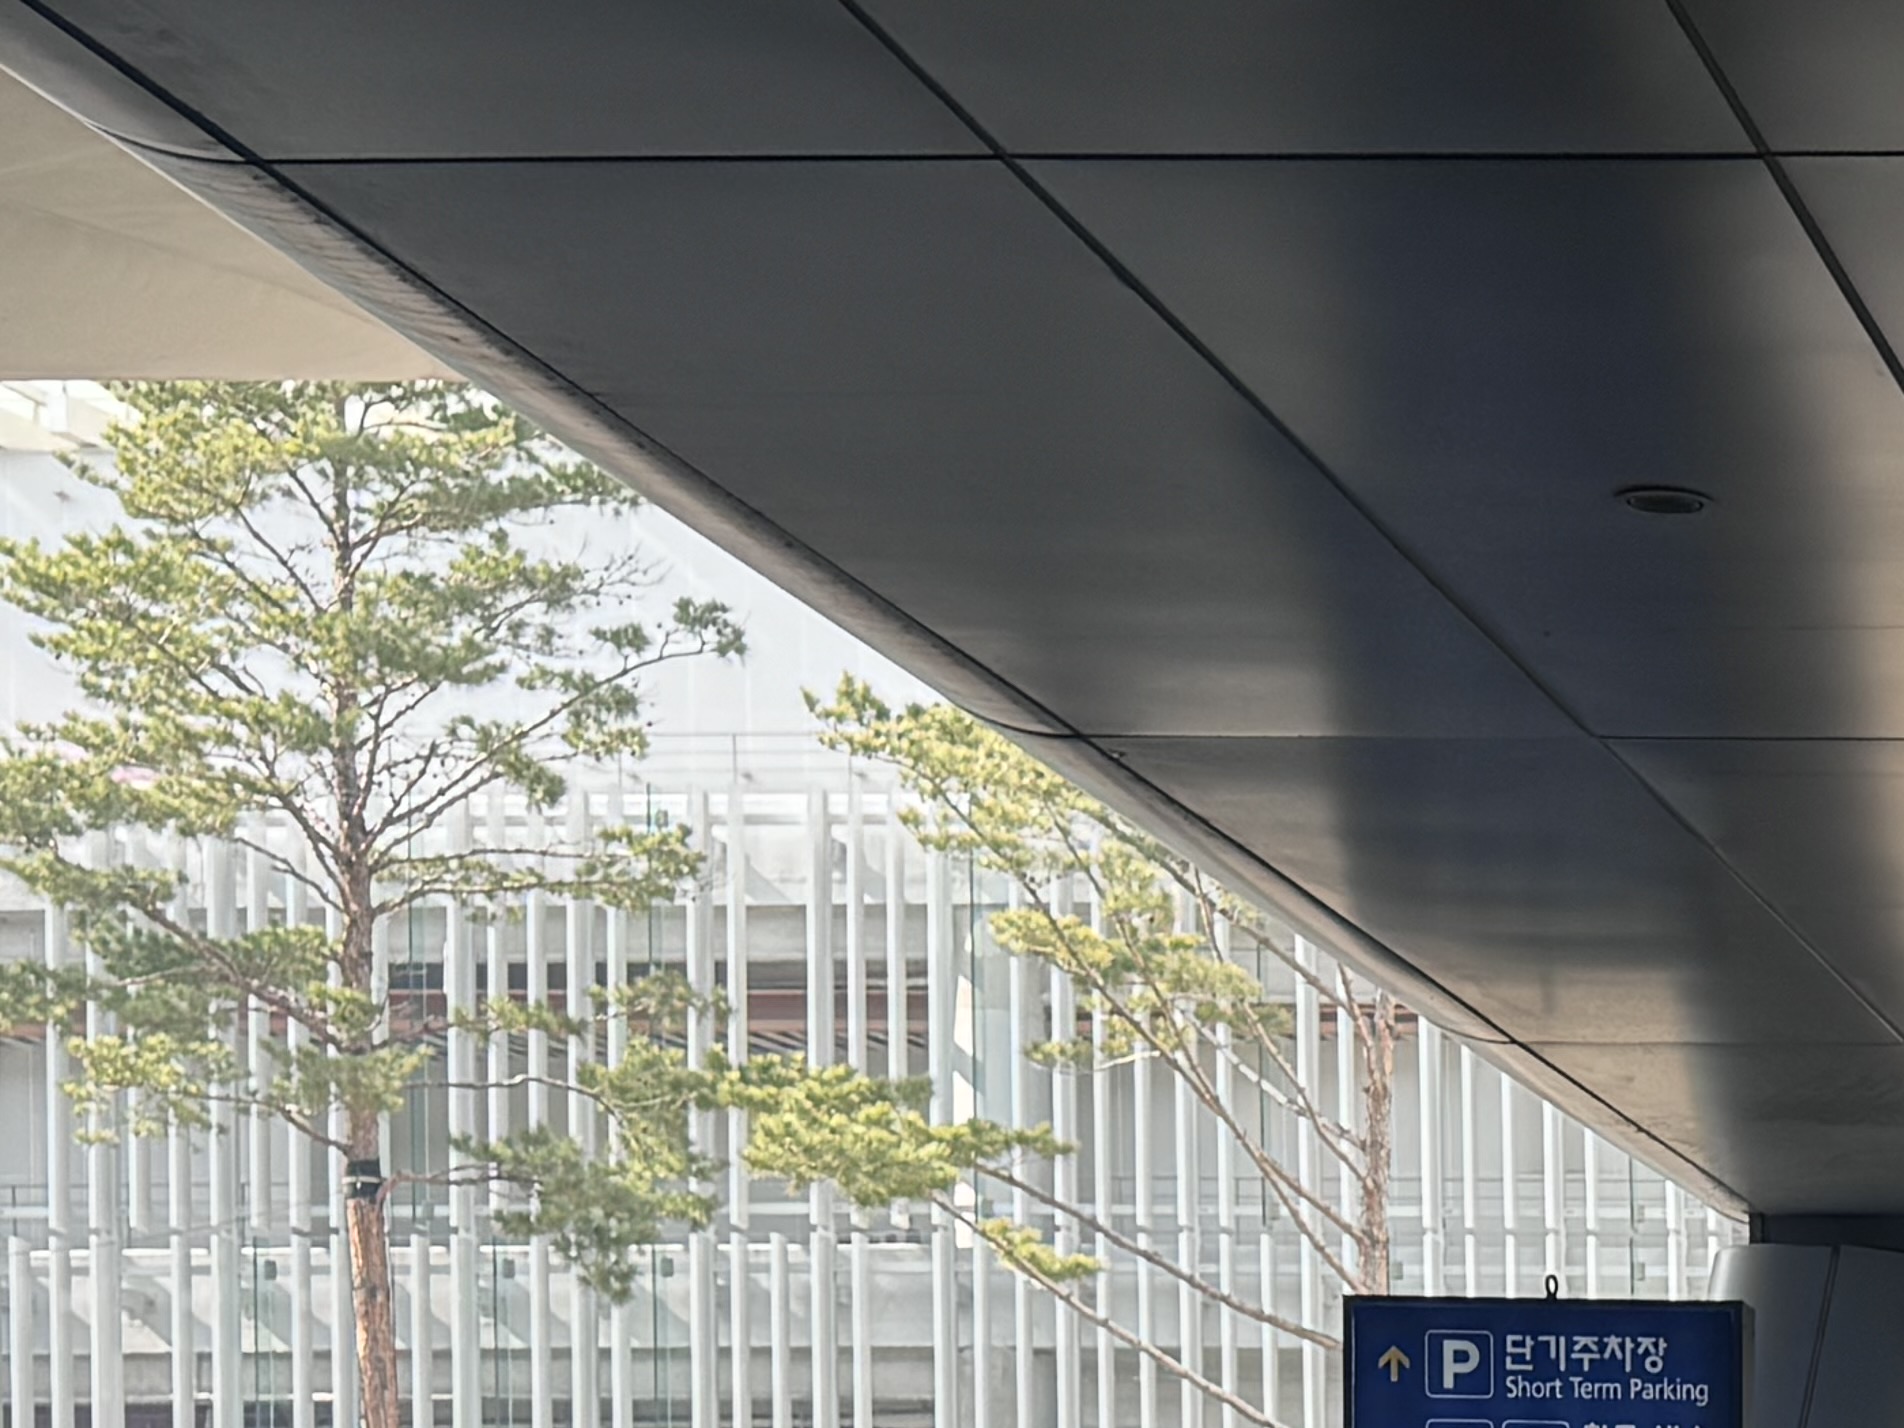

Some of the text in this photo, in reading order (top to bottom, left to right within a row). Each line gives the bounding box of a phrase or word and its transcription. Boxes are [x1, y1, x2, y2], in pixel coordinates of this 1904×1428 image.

[1442, 1339, 1480, 1390] P
[1505, 1334, 1668, 1374] 단기주차장
[1505, 1374, 1709, 1407] Short Term Parking
